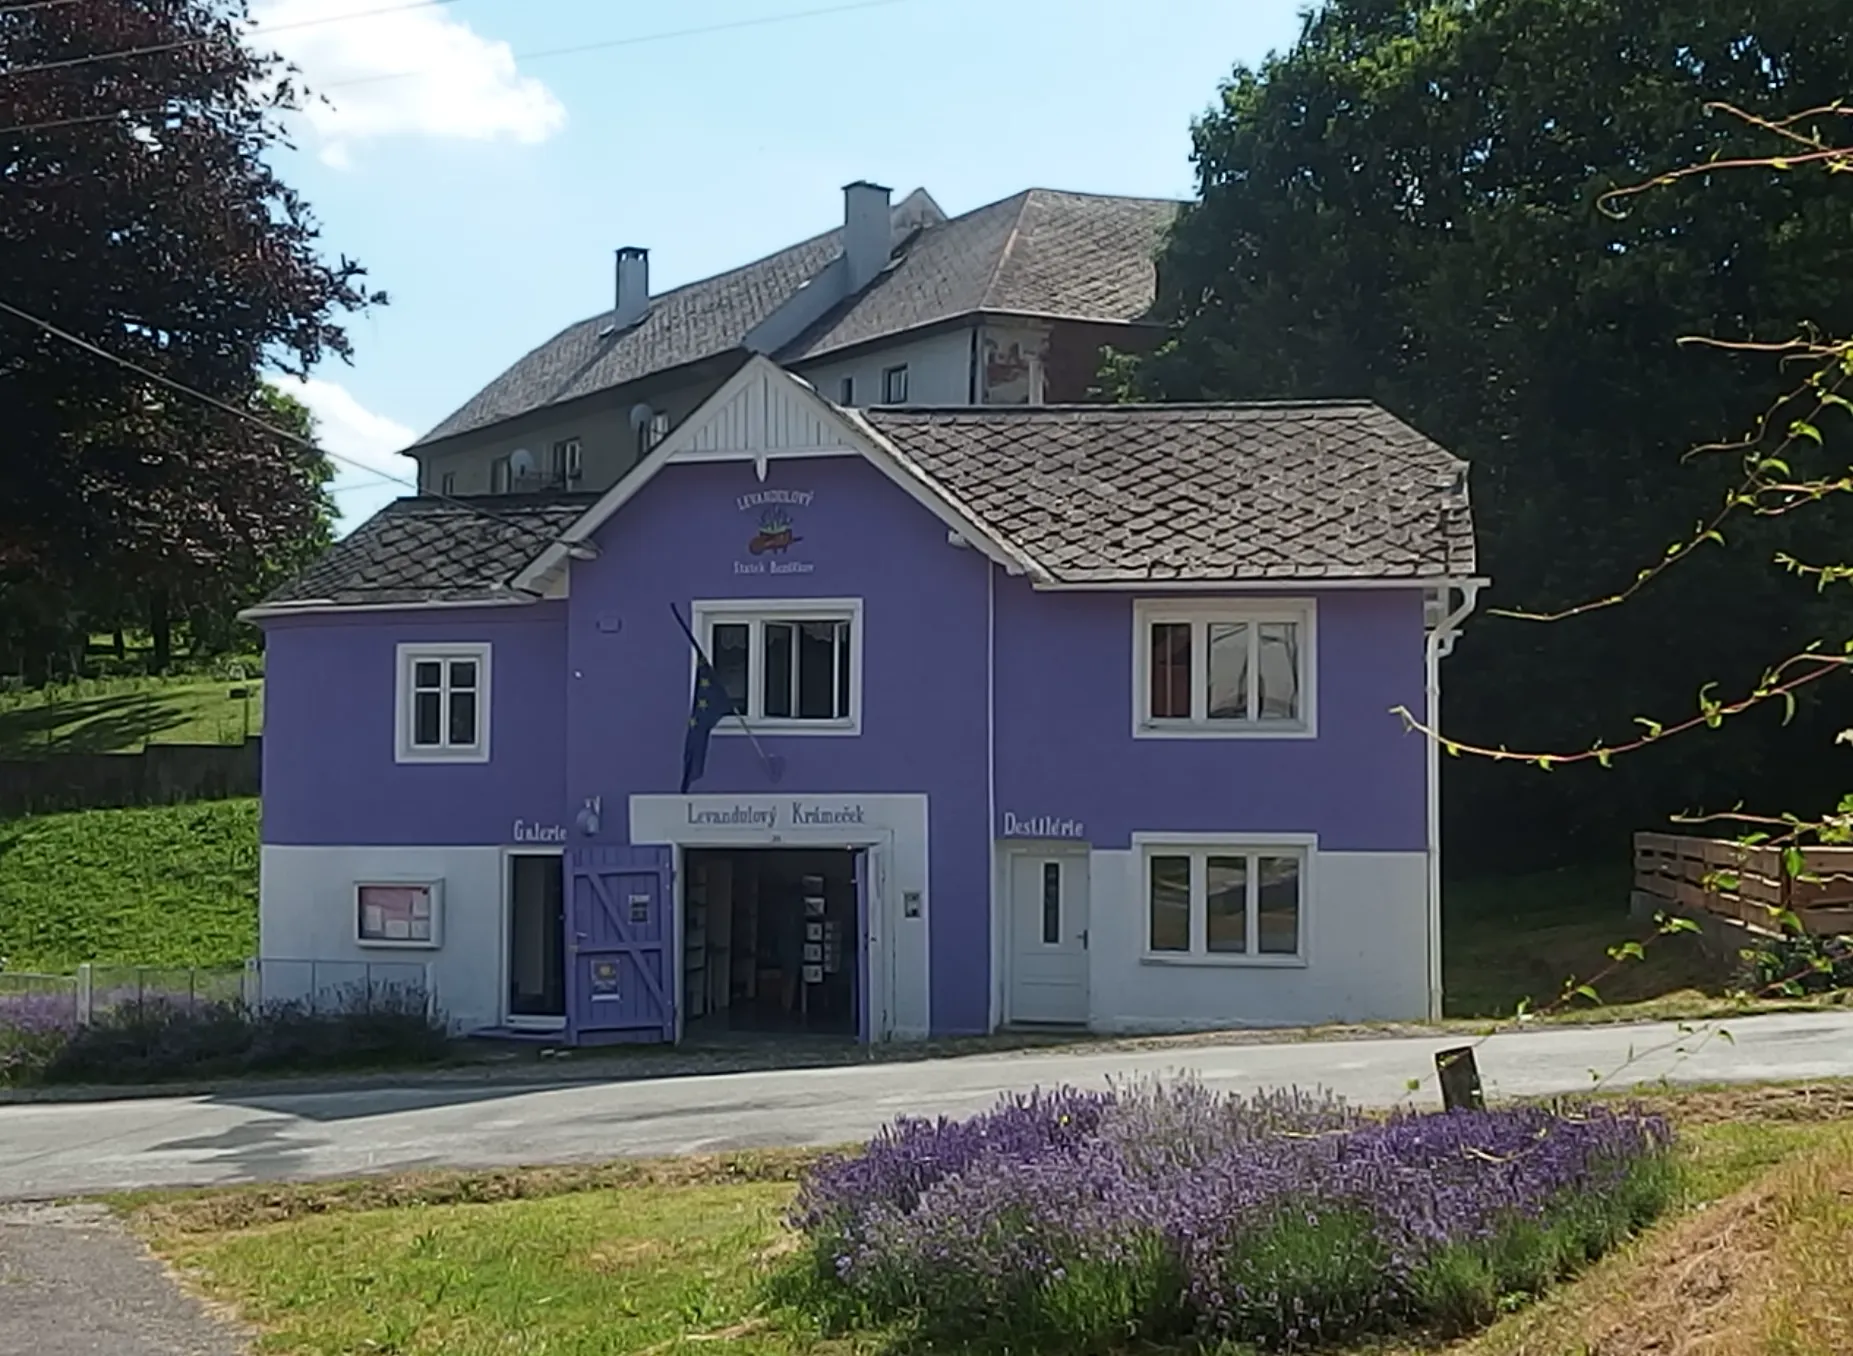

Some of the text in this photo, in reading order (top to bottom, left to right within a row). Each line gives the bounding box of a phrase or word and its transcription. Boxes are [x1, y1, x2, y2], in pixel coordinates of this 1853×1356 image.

[687, 801, 865, 828] Levandulový Krámeček
[514, 819, 567, 841] Galerie
